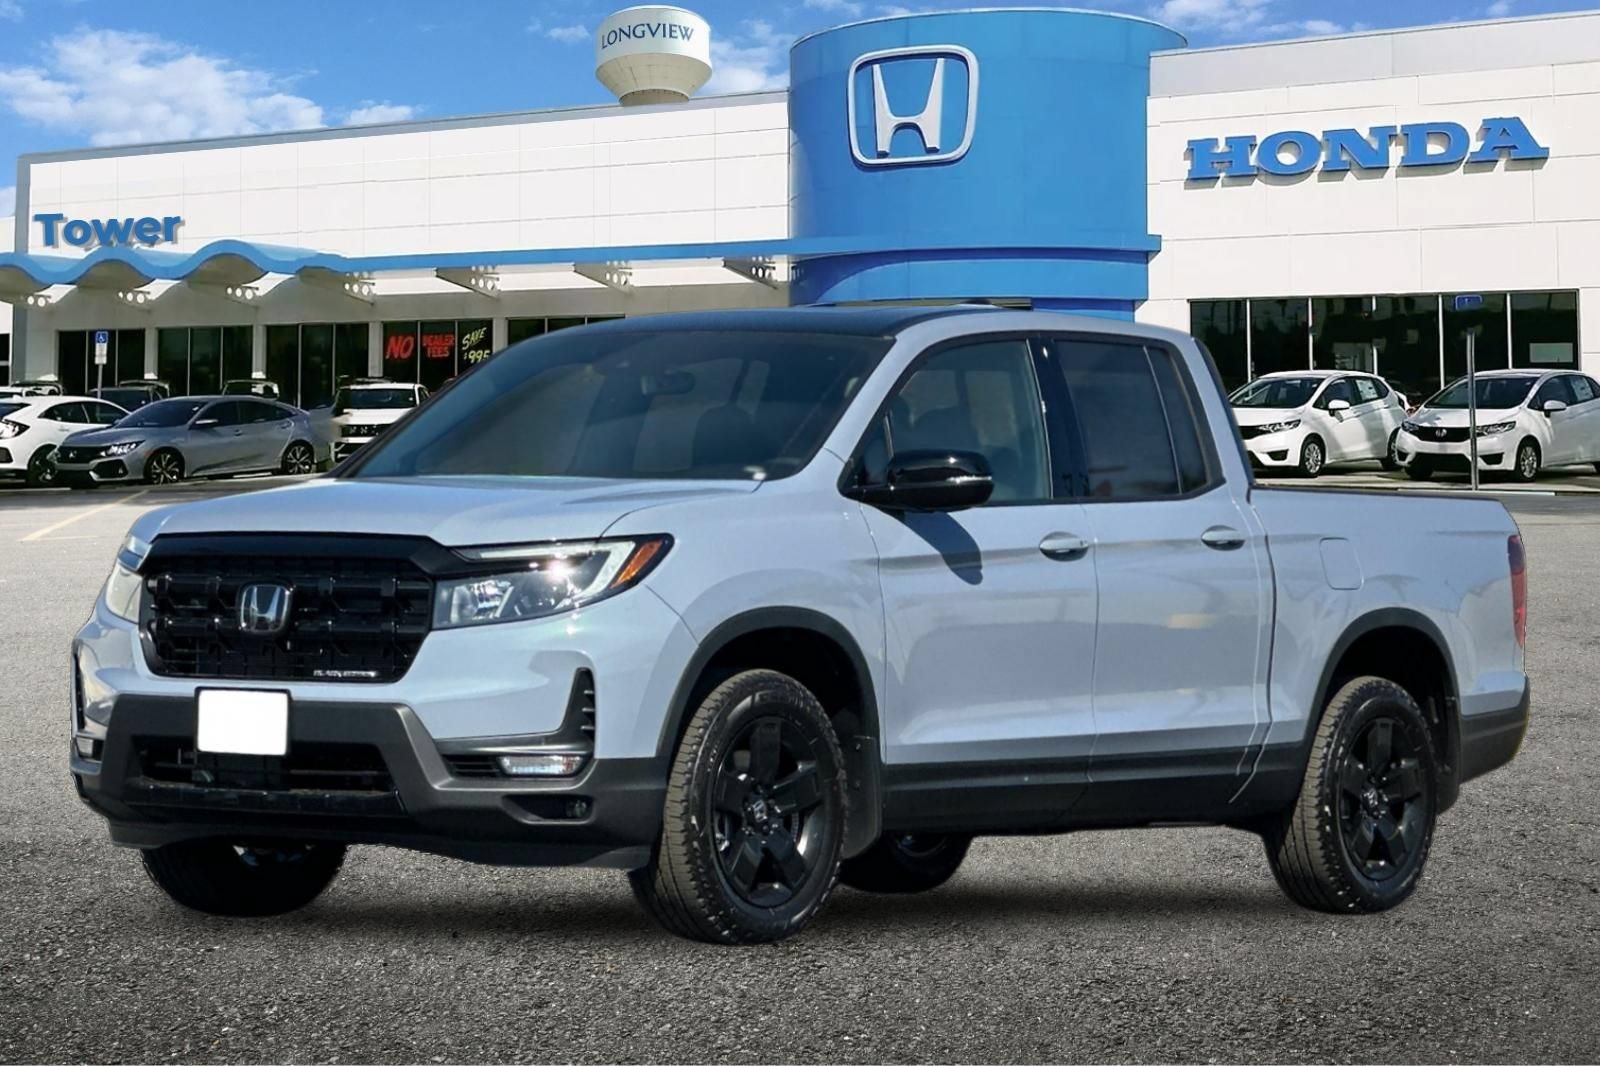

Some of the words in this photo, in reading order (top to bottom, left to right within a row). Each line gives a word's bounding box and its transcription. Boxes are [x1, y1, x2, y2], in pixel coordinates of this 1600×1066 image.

[601, 23, 695, 50] LONGVIEW
[1185, 116, 1550, 188] HONDA
[33, 213, 184, 248] Tower
[385, 335, 415, 359] NO
[462, 327, 487, 350] SAVE
